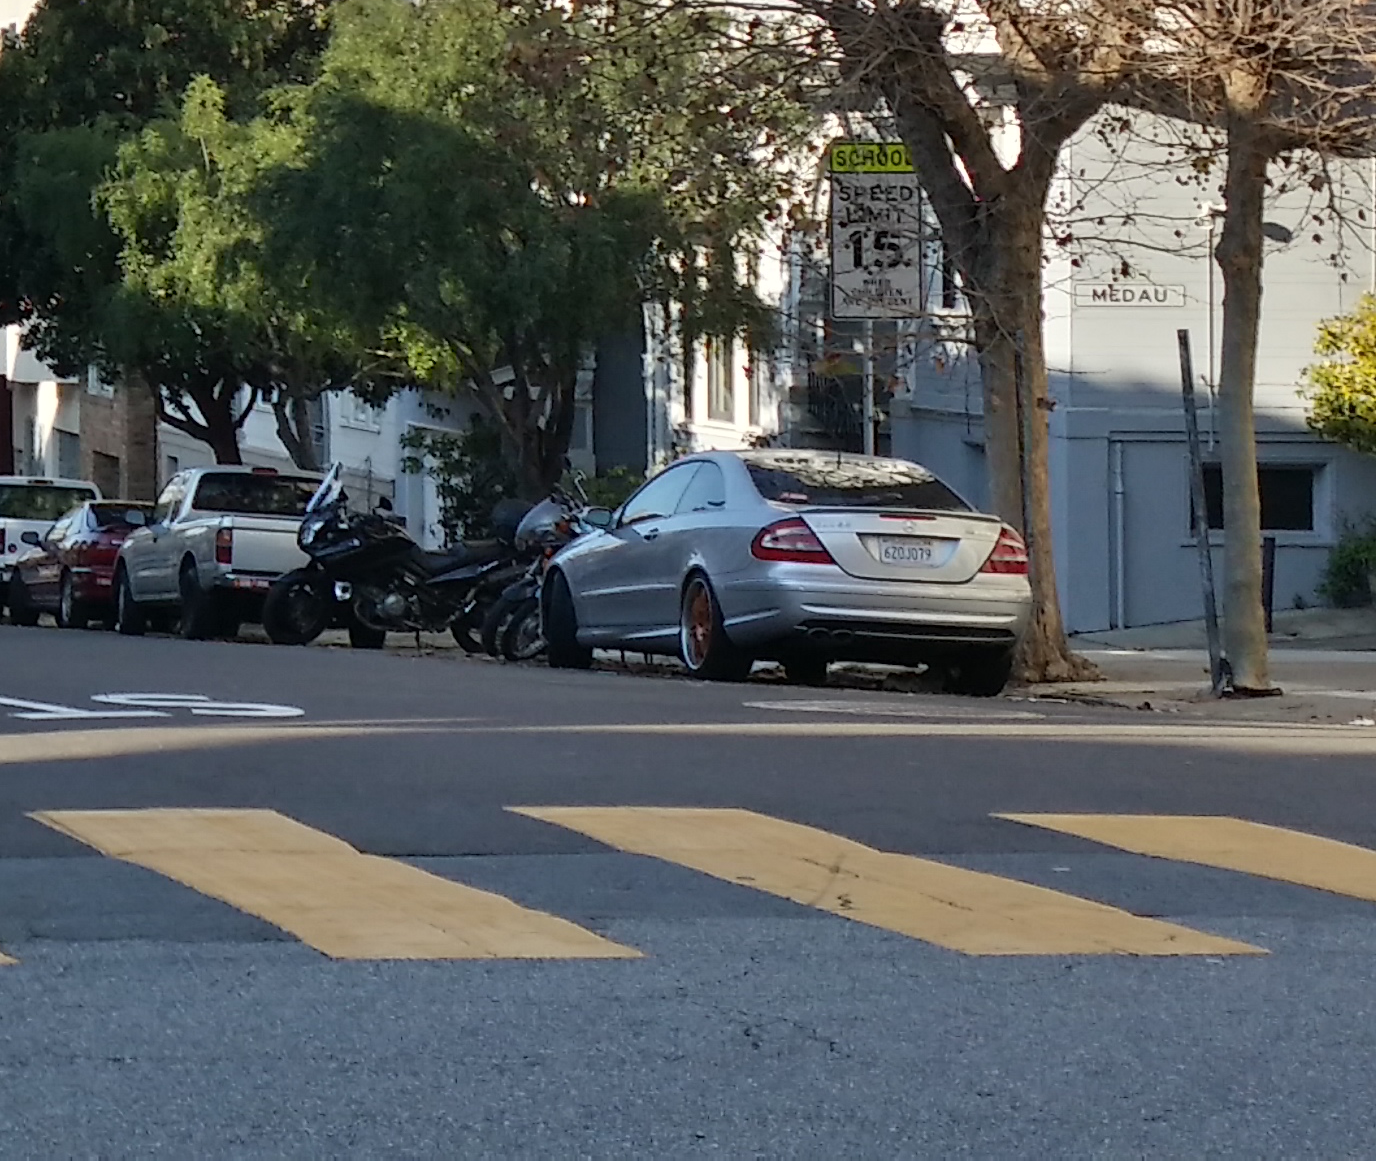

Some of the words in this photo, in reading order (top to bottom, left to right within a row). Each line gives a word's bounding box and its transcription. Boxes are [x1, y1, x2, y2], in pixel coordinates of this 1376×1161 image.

[839, 185, 913, 202] SPEED
[846, 207, 905, 224] LIMIT
[850, 230, 904, 268] 15
[1092, 288, 1168, 303] MEDAU
